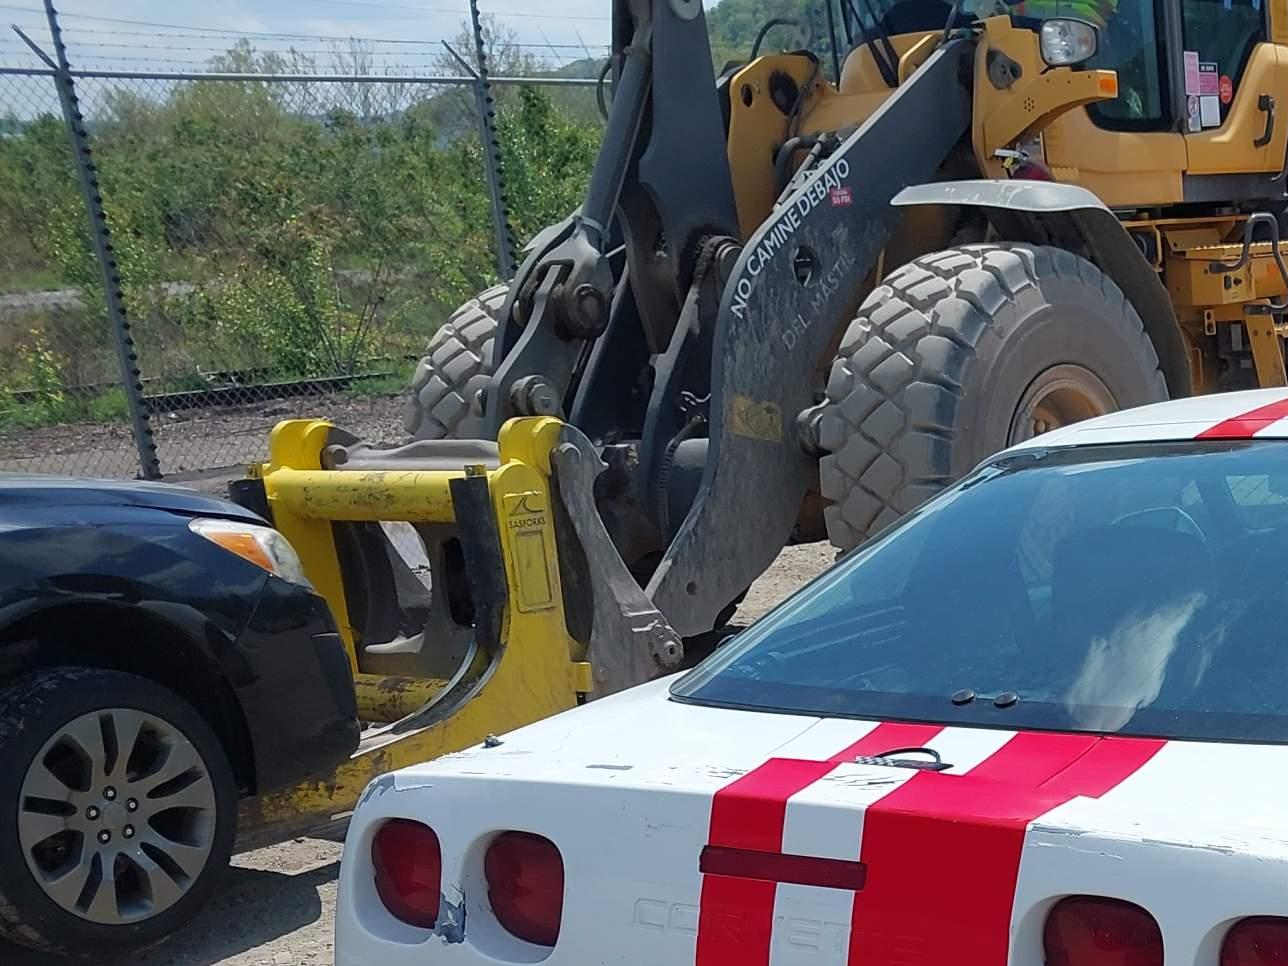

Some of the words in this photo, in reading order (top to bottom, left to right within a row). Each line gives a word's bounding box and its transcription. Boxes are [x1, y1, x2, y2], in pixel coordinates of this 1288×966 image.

[731, 279, 751, 319] NO
[747, 208, 801, 276] CAMINE
[797, 159, 849, 217] DEBAJO
